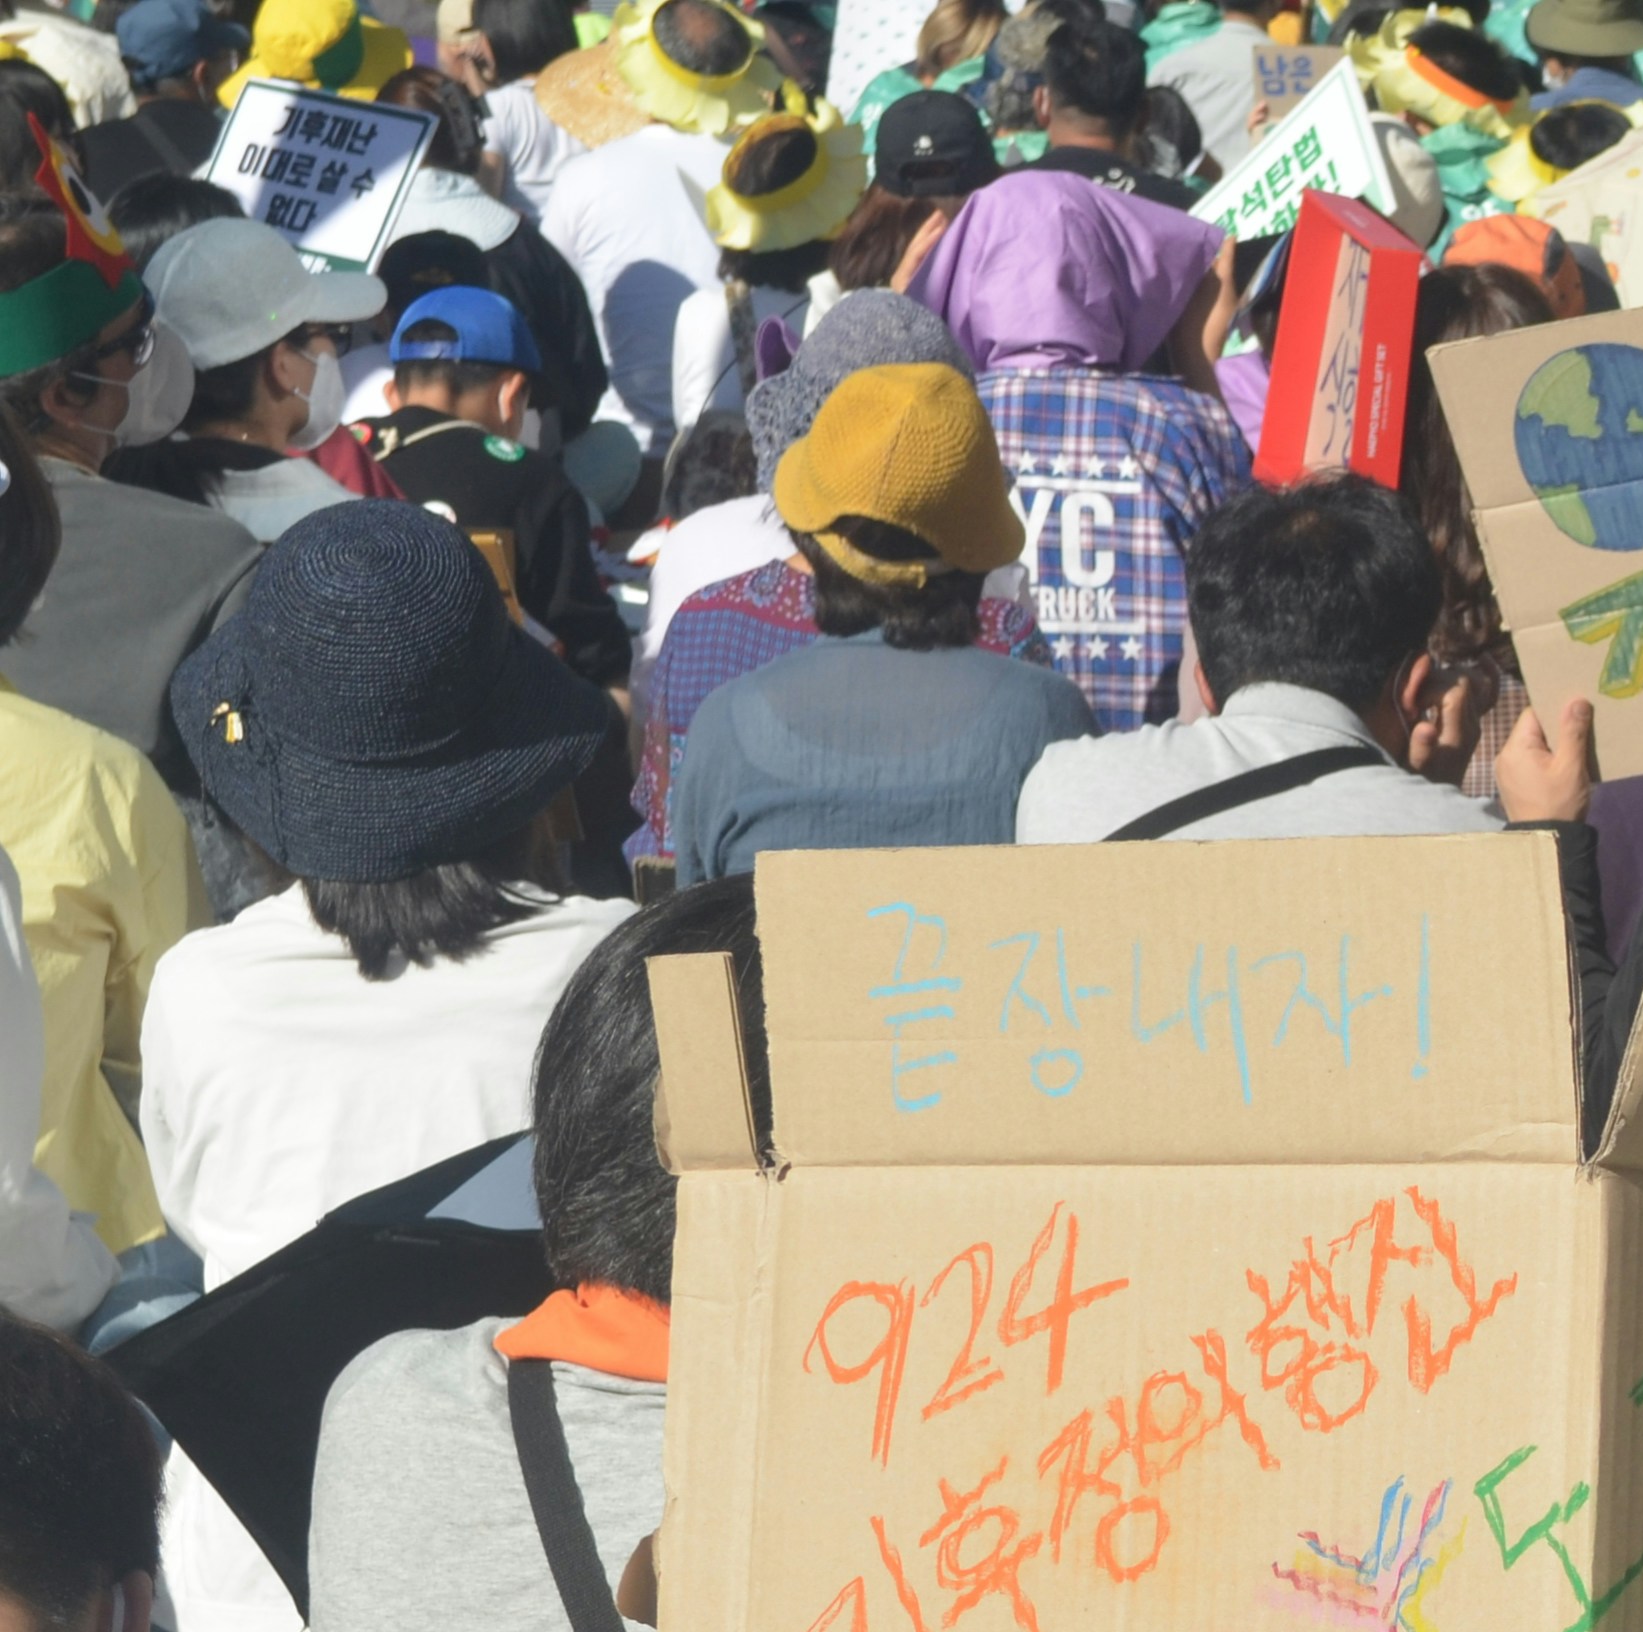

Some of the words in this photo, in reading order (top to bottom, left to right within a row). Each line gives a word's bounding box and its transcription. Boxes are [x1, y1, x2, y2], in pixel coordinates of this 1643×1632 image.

[1258, 55, 1314, 96] 남은
[273, 106, 378, 155] 기후재난
[238, 143, 317, 188] 이대로
[316, 160, 348, 194] 살
[351, 167, 375, 199] 수
[265, 194, 317, 232] 없다
[1008, 485, 1116, 590] YC
[867, 901, 1430, 1112] 끝장내자!
[803, 1199, 1128, 1468] 924
